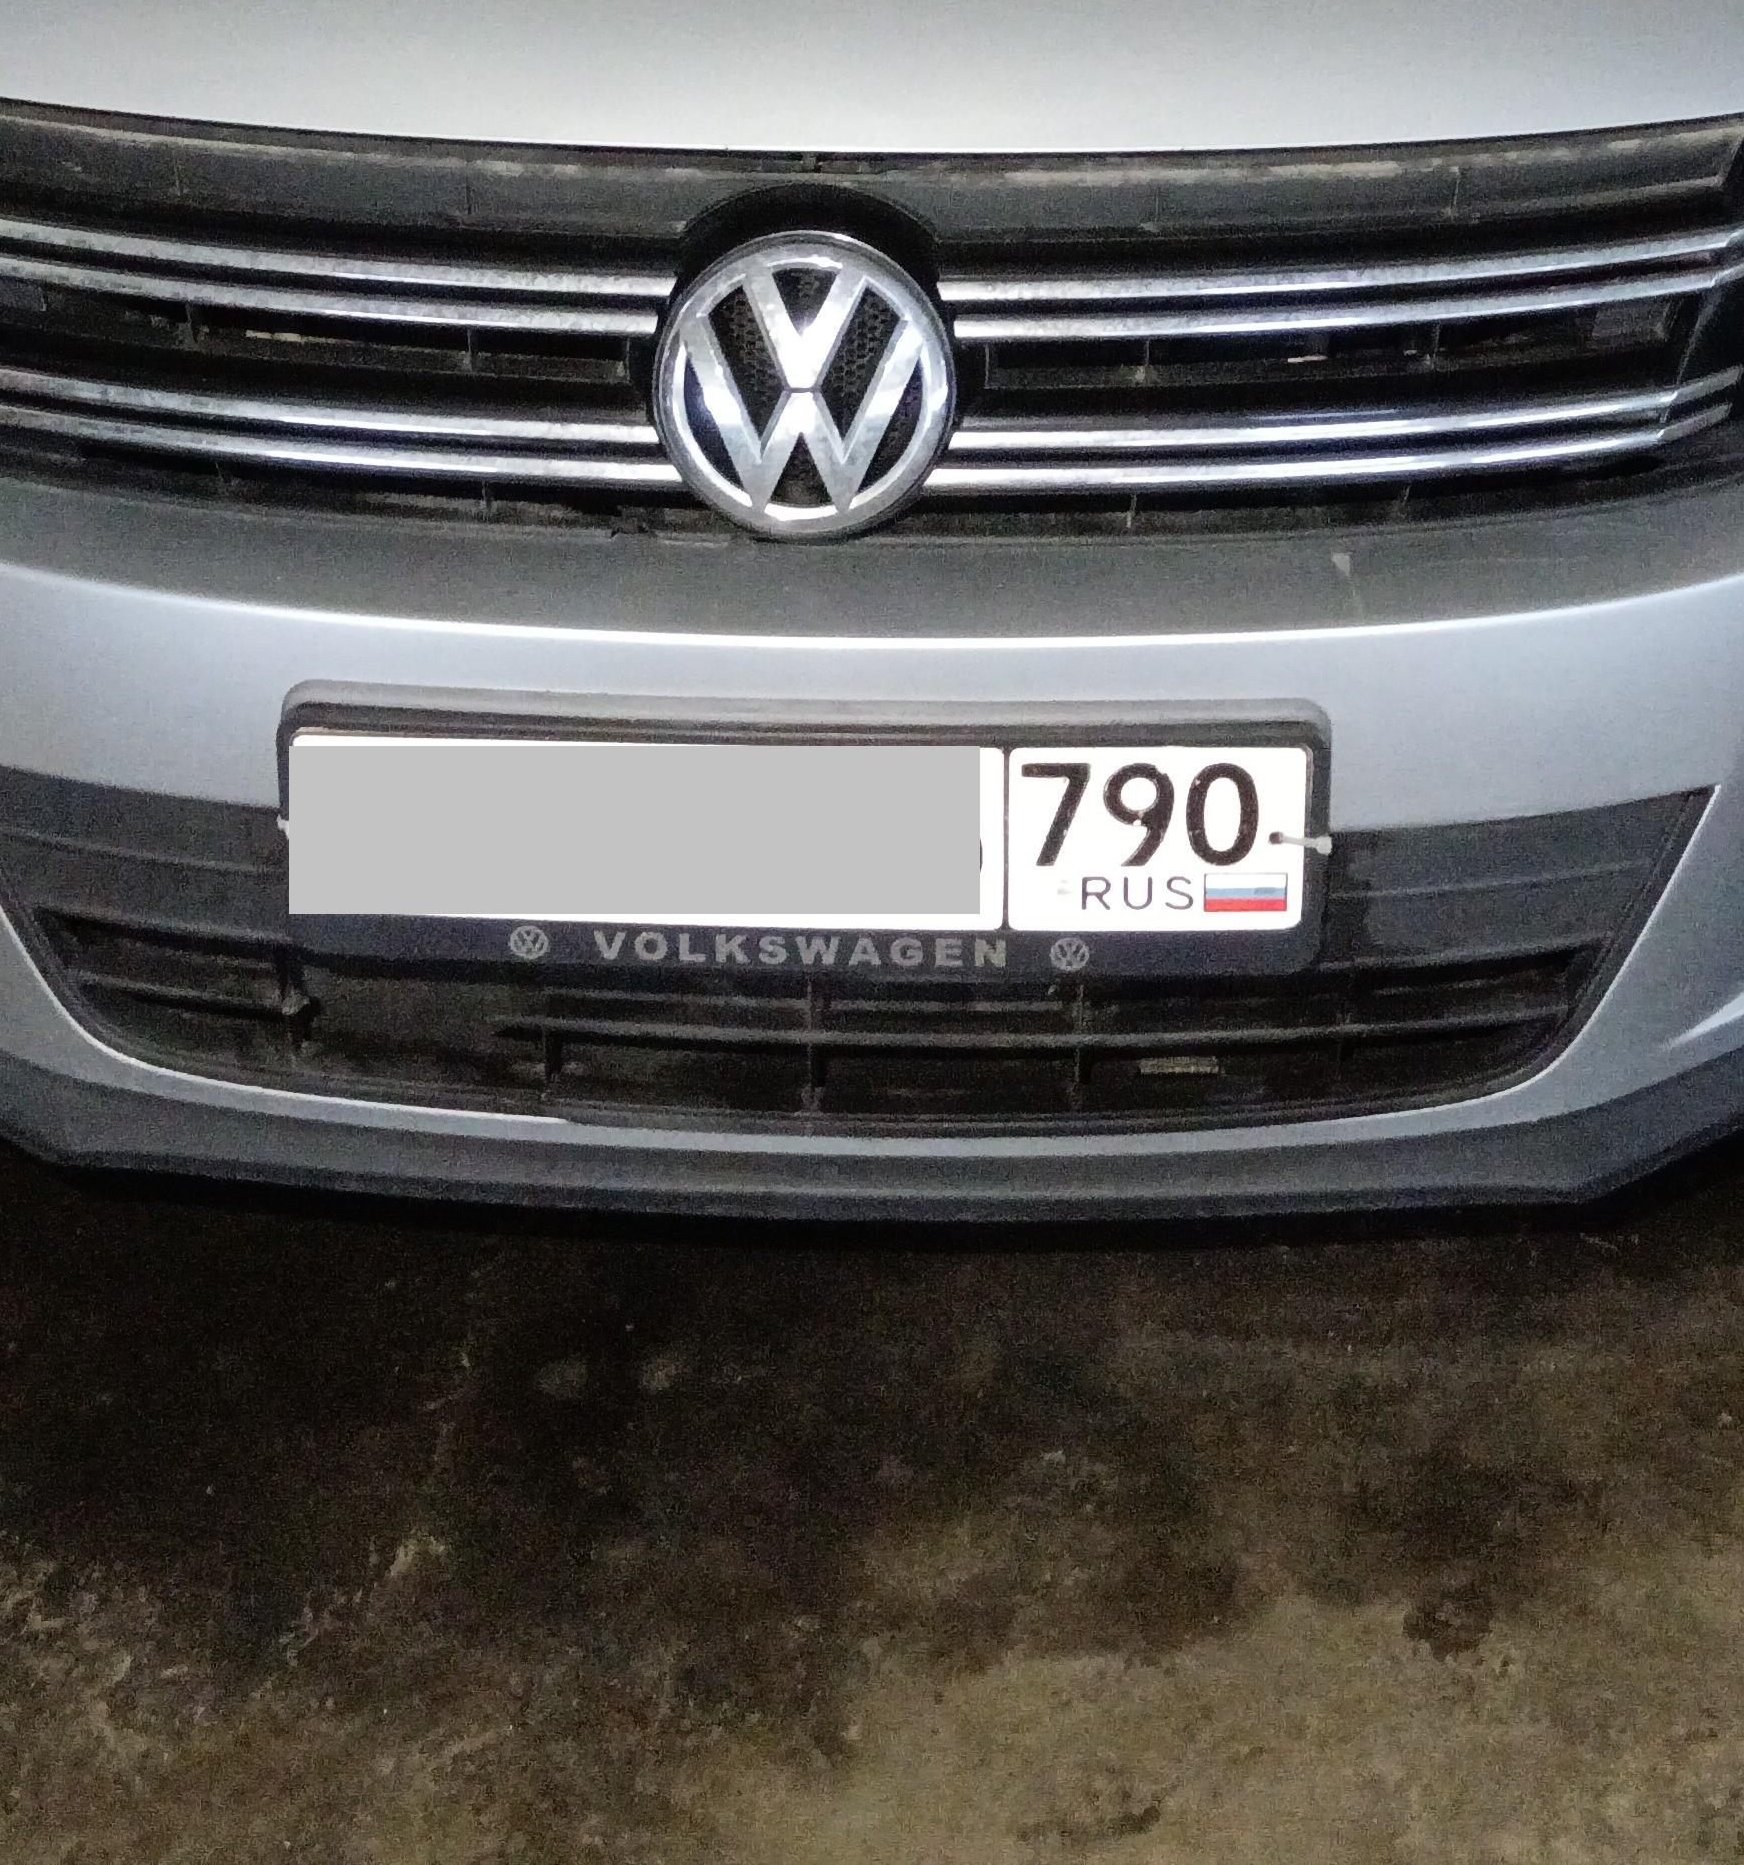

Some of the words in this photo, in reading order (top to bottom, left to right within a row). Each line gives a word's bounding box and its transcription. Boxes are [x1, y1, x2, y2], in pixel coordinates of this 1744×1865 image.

[663, 242, 945, 528] VW
[1021, 762, 1260, 867] 790
[1081, 875, 1195, 911] RUS
[593, 929, 1008, 968] VOLKSWAGEN
